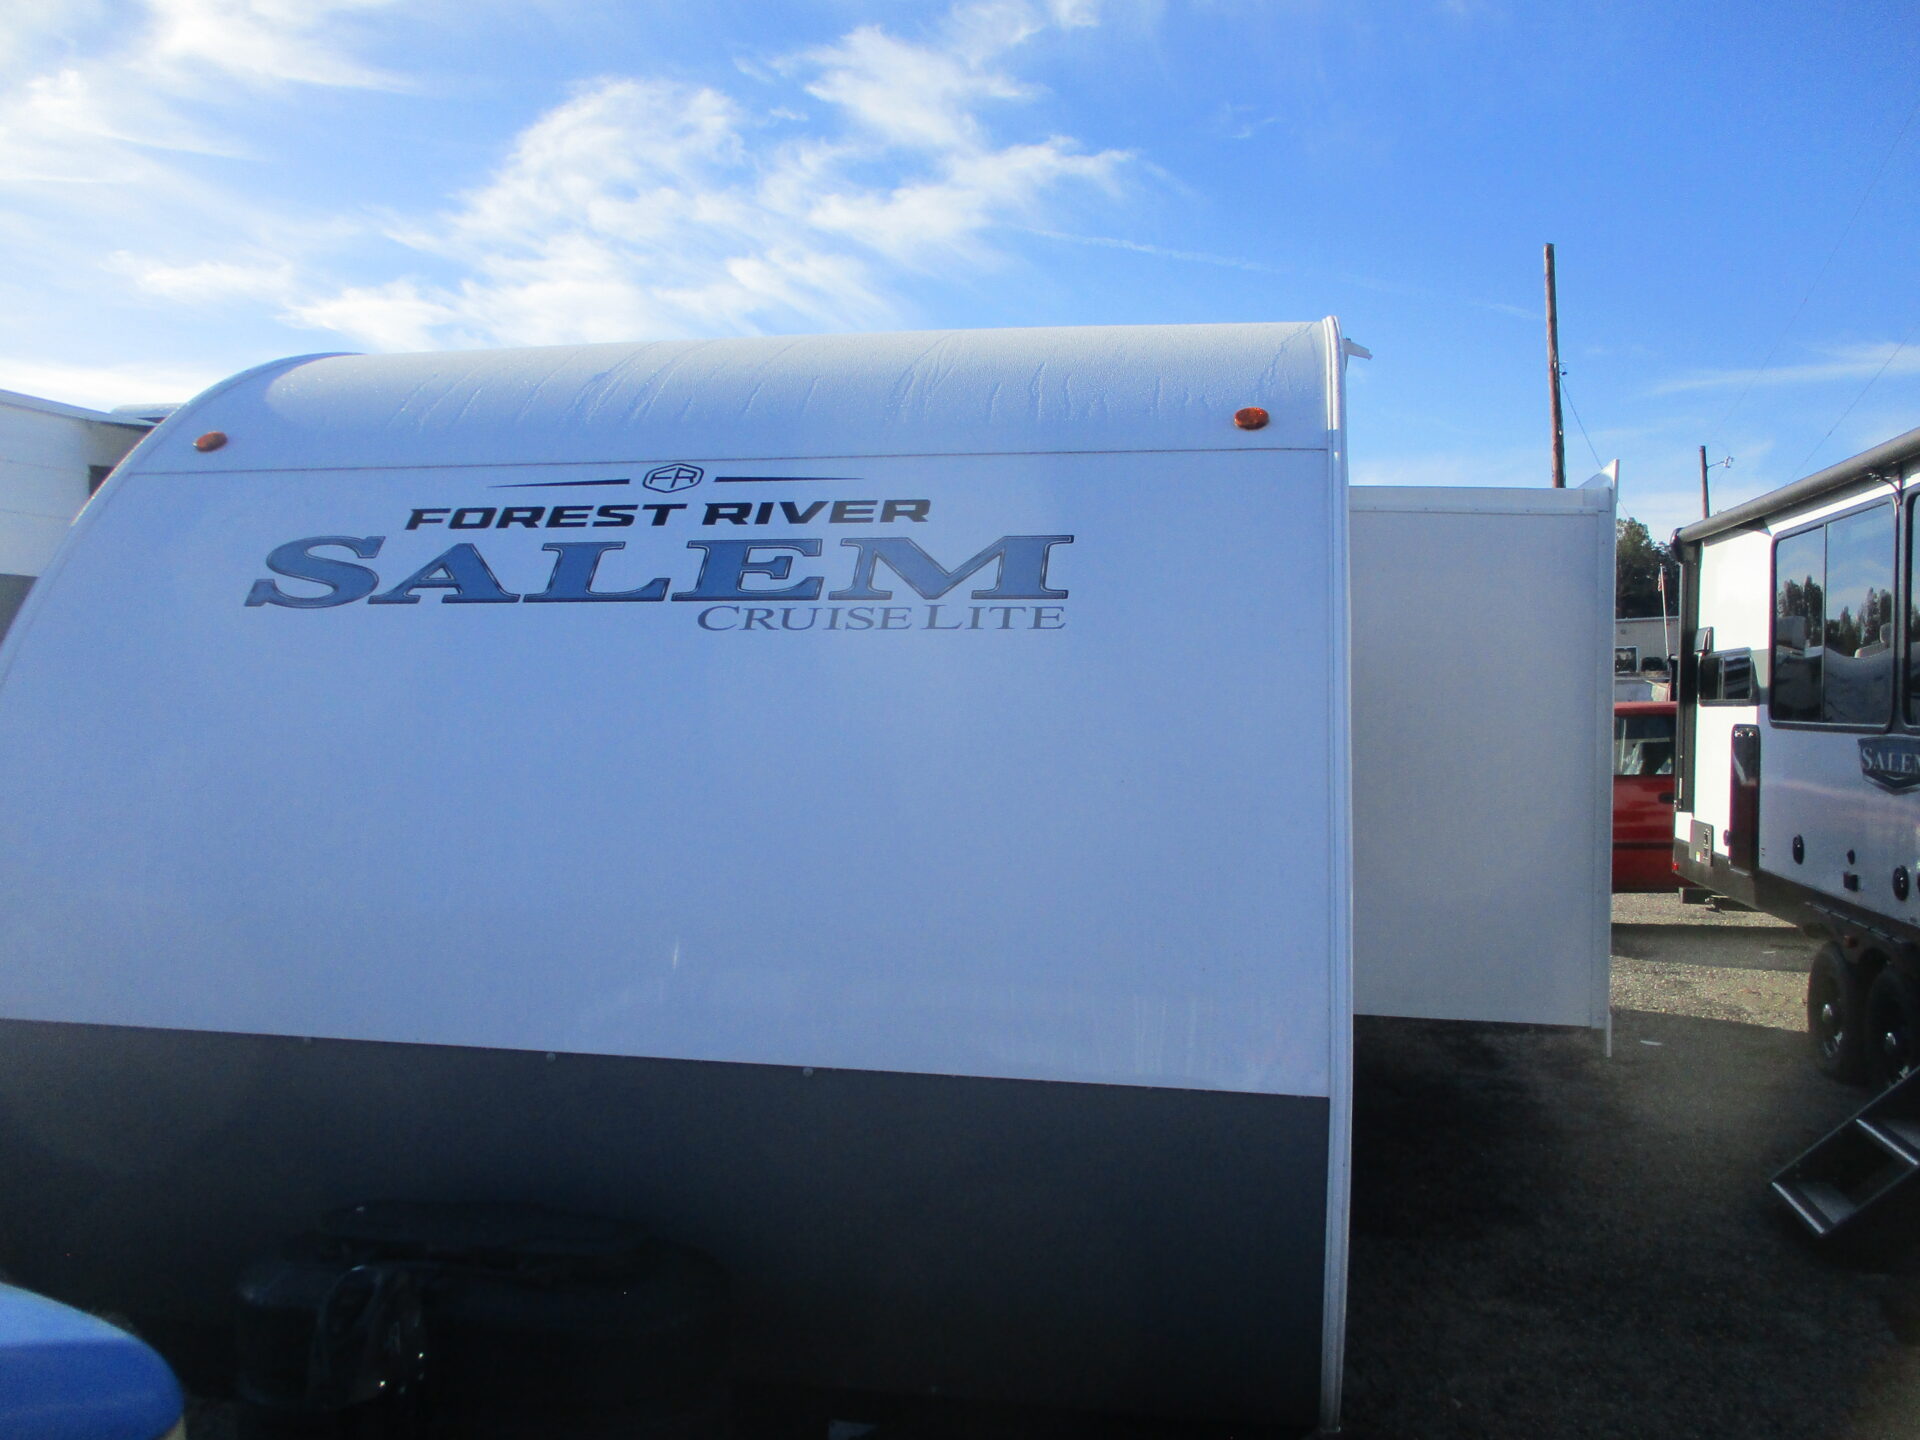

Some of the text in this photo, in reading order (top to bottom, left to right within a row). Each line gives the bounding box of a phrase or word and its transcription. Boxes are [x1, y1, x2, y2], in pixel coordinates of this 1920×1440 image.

[648, 465, 699, 489] FR
[405, 499, 931, 531] FOREST RIVER
[244, 534, 1075, 607] SALEM
